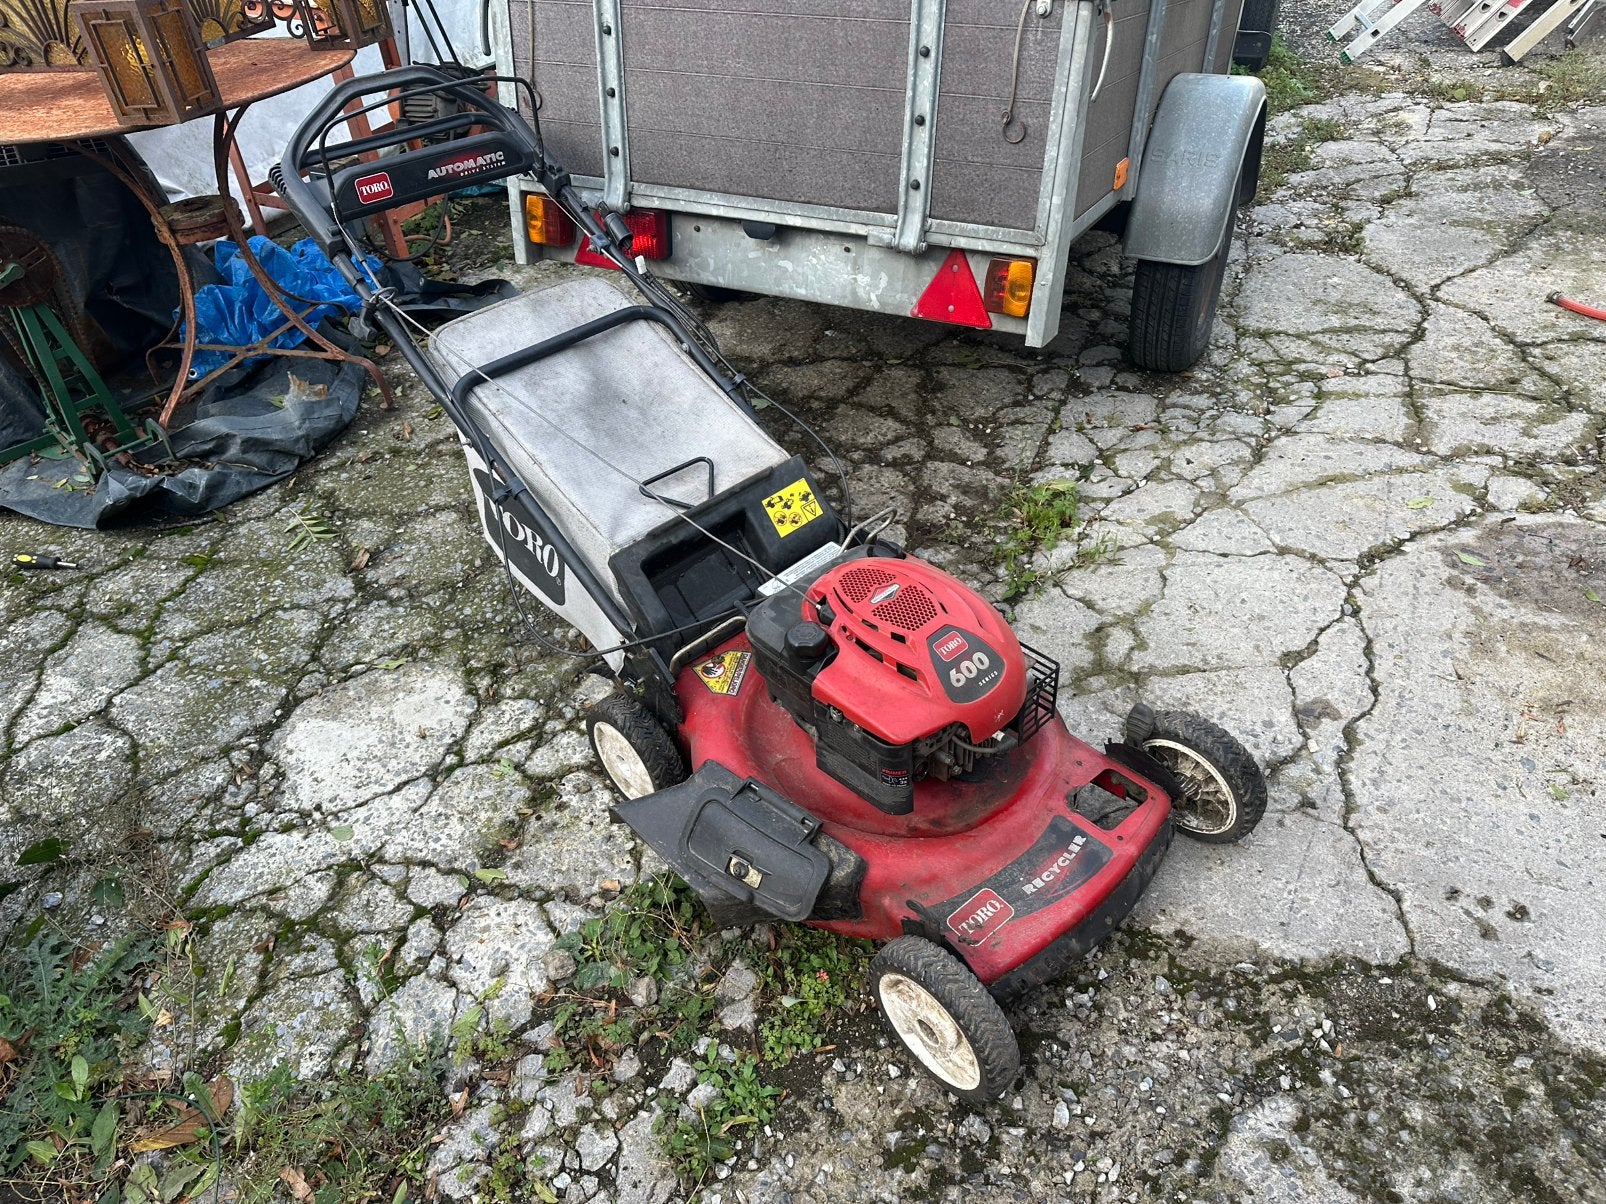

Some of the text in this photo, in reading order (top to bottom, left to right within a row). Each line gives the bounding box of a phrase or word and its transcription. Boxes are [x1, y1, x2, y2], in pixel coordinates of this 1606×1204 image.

[427, 151, 504, 180] AUTOMATIC
[460, 161, 506, 177] DRIVE SYSTEM
[1150, 146, 1221, 170] SARIS
[360, 181, 389, 196] TORO
[939, 637, 963, 656] TORO
[949, 651, 990, 688] 600
[978, 670, 999, 687] SERIES
[1022, 834, 1087, 896] RECYCLER
[958, 899, 1004, 935] TORO
